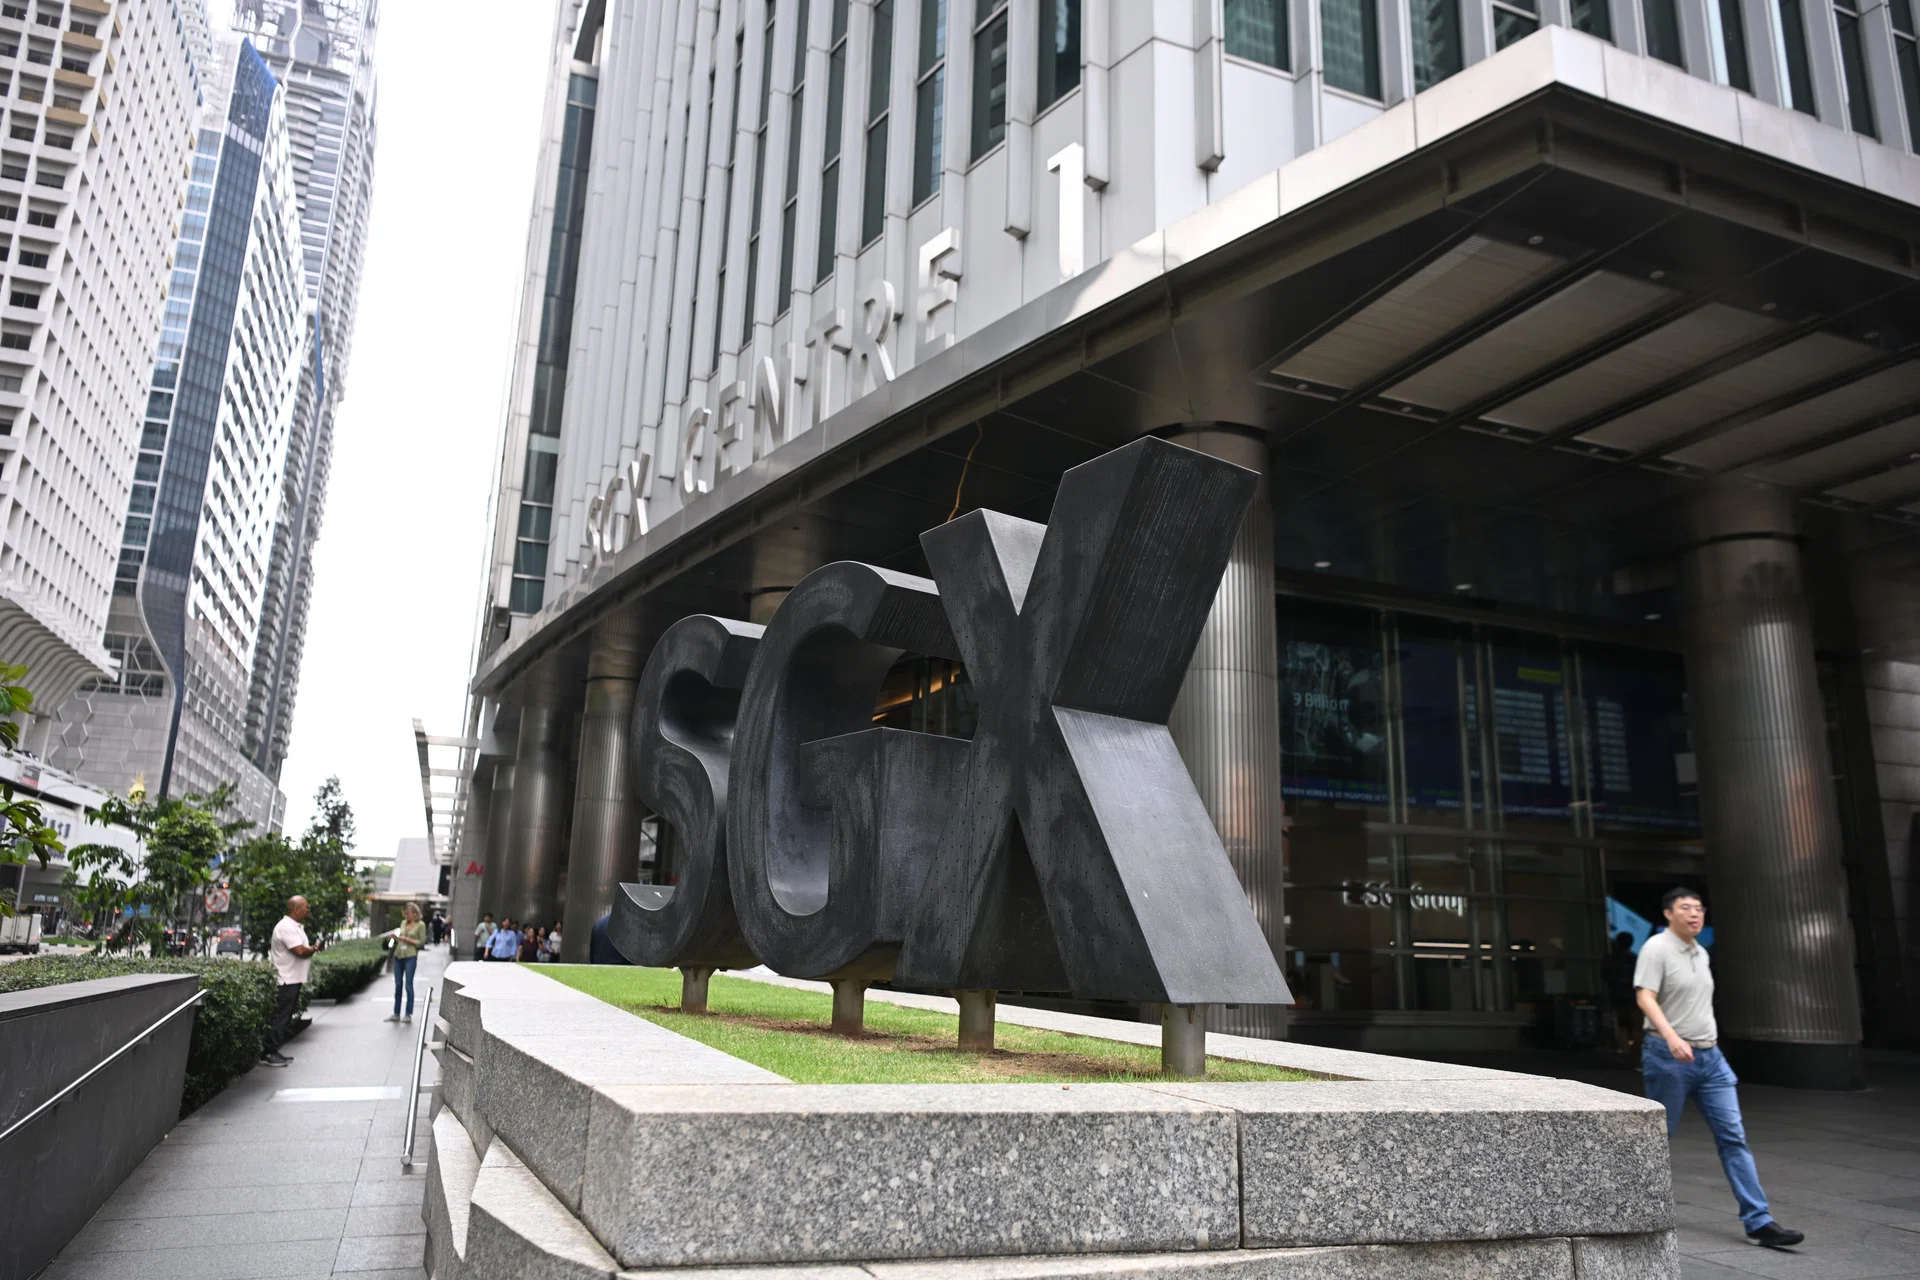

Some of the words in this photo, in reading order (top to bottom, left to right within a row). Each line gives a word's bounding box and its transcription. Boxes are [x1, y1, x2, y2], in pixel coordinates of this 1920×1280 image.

[581, 452, 652, 580] SGX
[680, 227, 961, 506] CENTRE
[1047, 142, 1085, 284] 1
[607, 435, 1295, 1005] SGX
